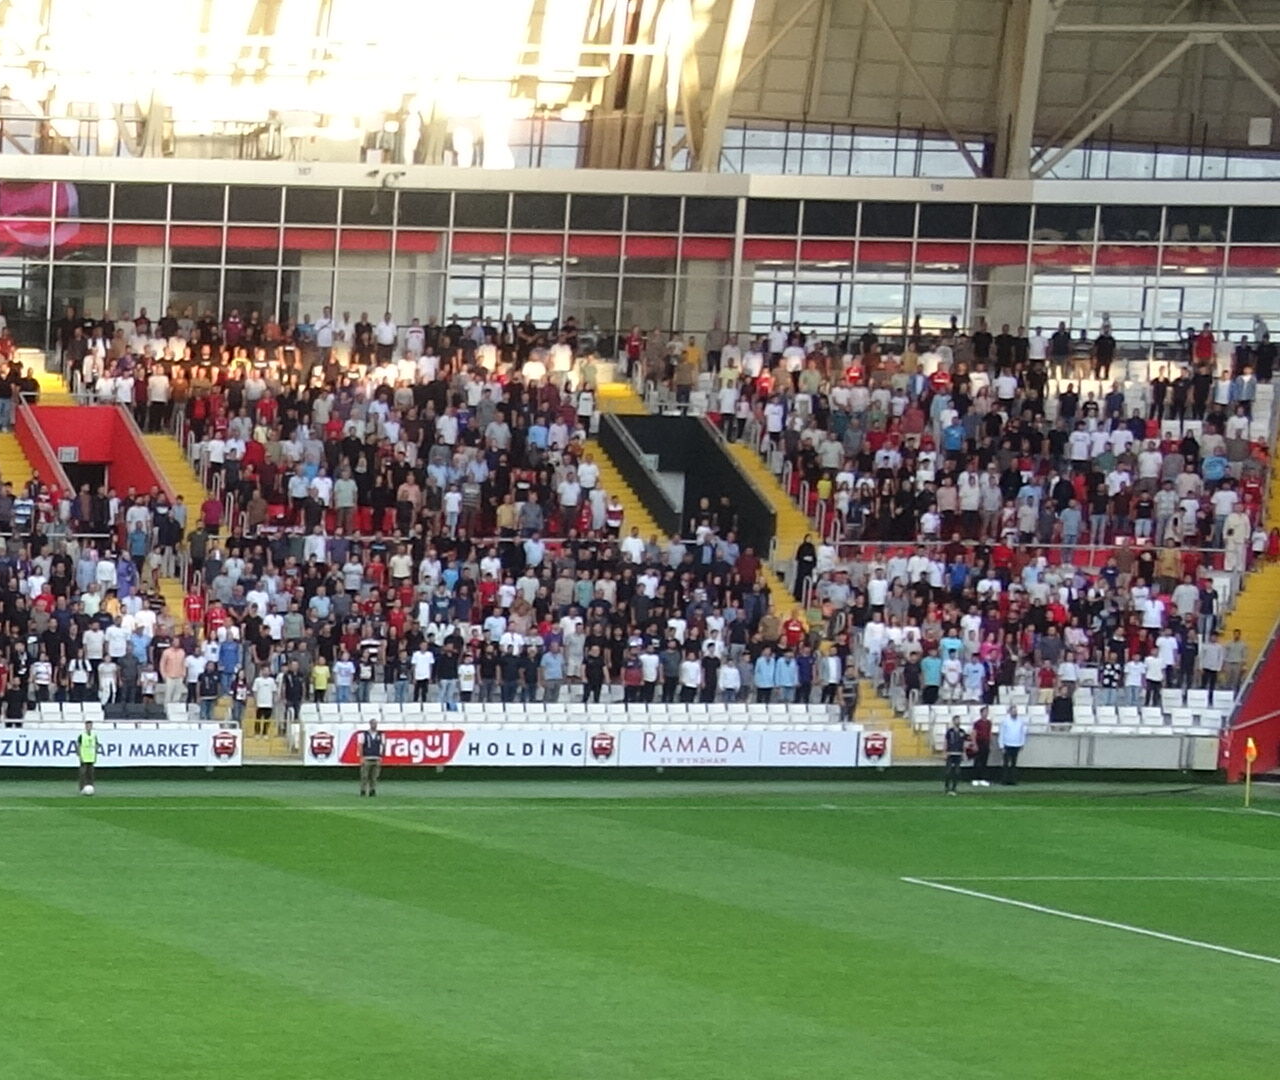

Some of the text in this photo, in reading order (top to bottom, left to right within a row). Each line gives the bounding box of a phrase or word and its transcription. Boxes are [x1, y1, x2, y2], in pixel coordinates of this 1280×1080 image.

[468, 740, 583, 757] HOLDİNG
[642, 731, 746, 753] RAMADA
[778, 741, 831, 756] ERGAN
[129, 743, 200, 758] MARKET
